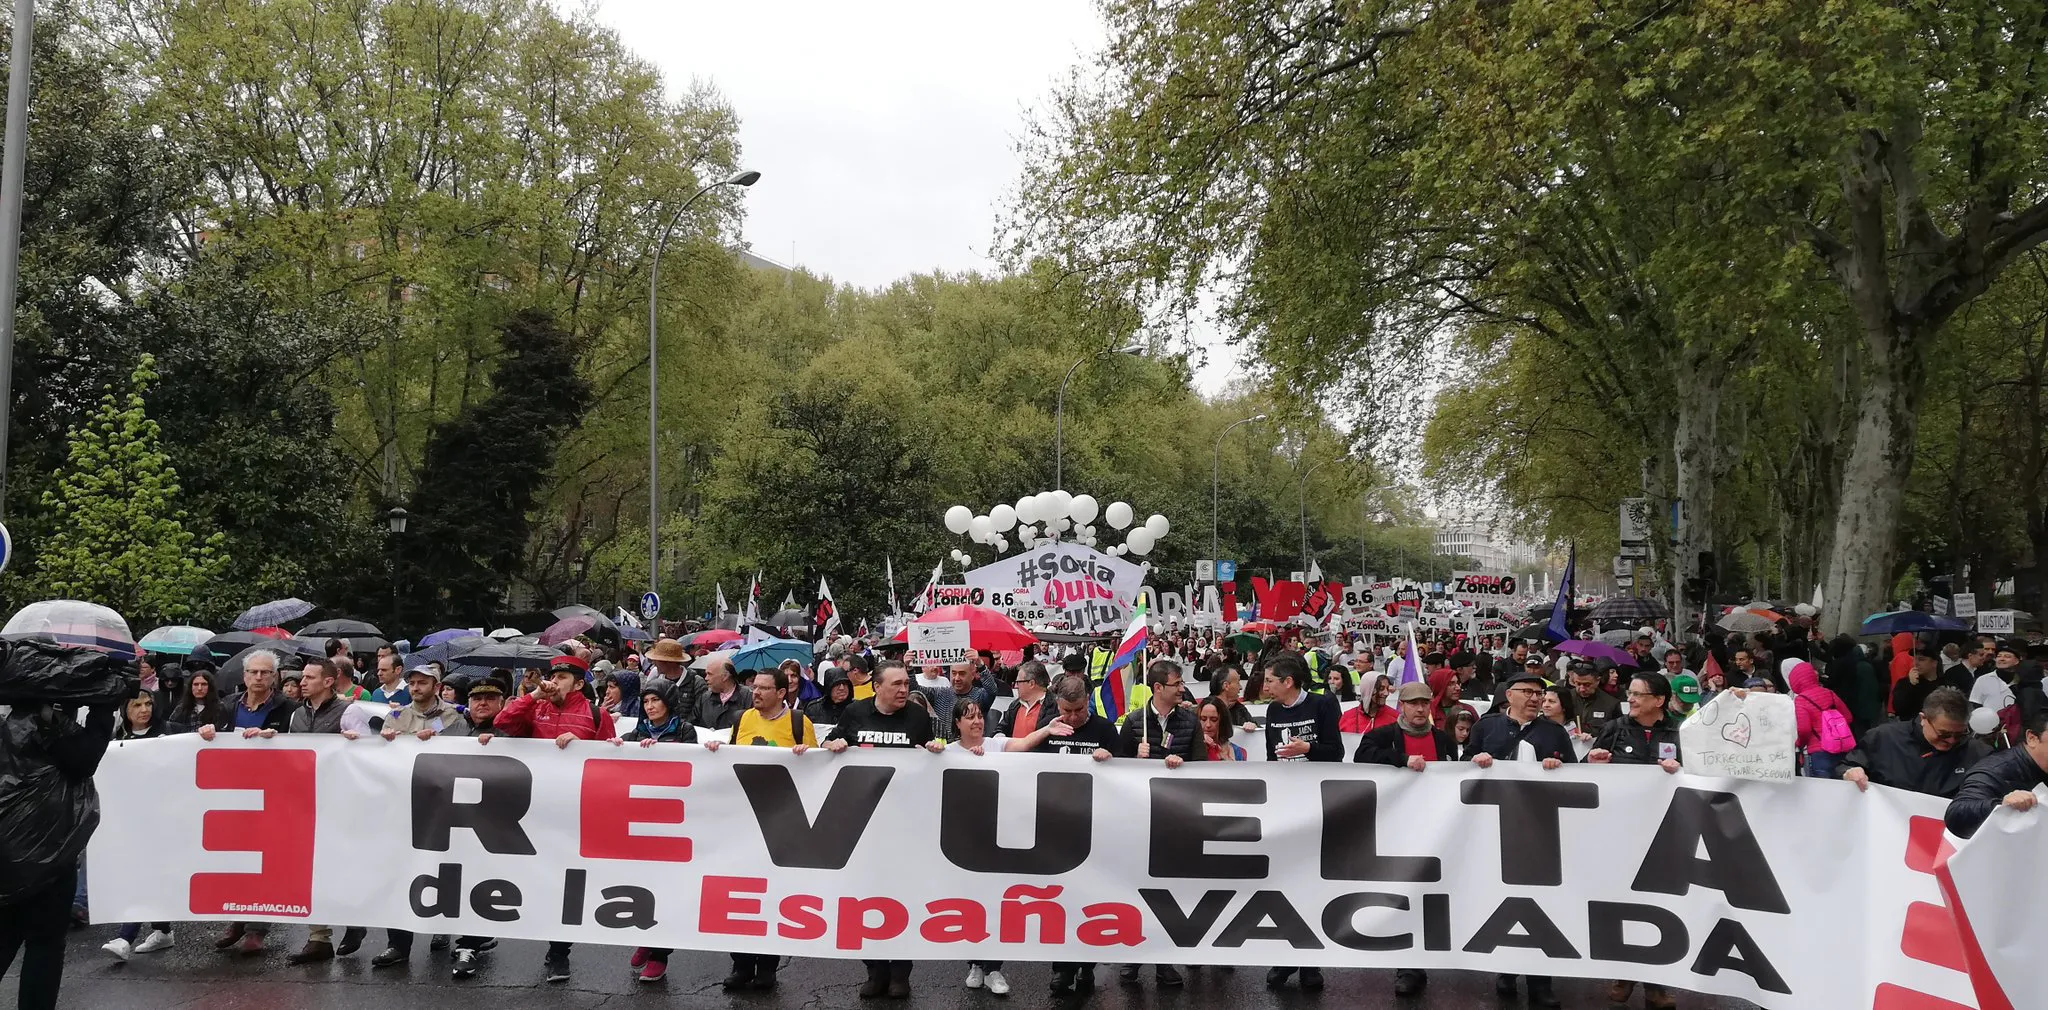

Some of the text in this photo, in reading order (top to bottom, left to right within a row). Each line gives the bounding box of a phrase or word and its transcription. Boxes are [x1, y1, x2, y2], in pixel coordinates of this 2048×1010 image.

[1017, 552, 1115, 588] #Soria
[1465, 575, 1500, 584] SORIA
[939, 587, 971, 597] SORIA
[1370, 582, 1392, 590] SORIA
[992, 593, 1014, 607] 8,6
[1345, 589, 1373, 606] 8,6
[1397, 591, 1419, 600] SORIA
[1419, 616, 1437, 627] 8,6
[912, 648, 966, 659] REVUELTA
[857, 730, 910, 744] TERUEL
[1697, 751, 1788, 766] TORRECILLA DEL
[1755, 768, 1792, 780] SEGOVIA
[411, 752, 1792, 915] REVUELTA
[222, 902, 309, 914] #EspañaVACIADA
[409, 861, 1793, 997] de la EspañaVACIADA
